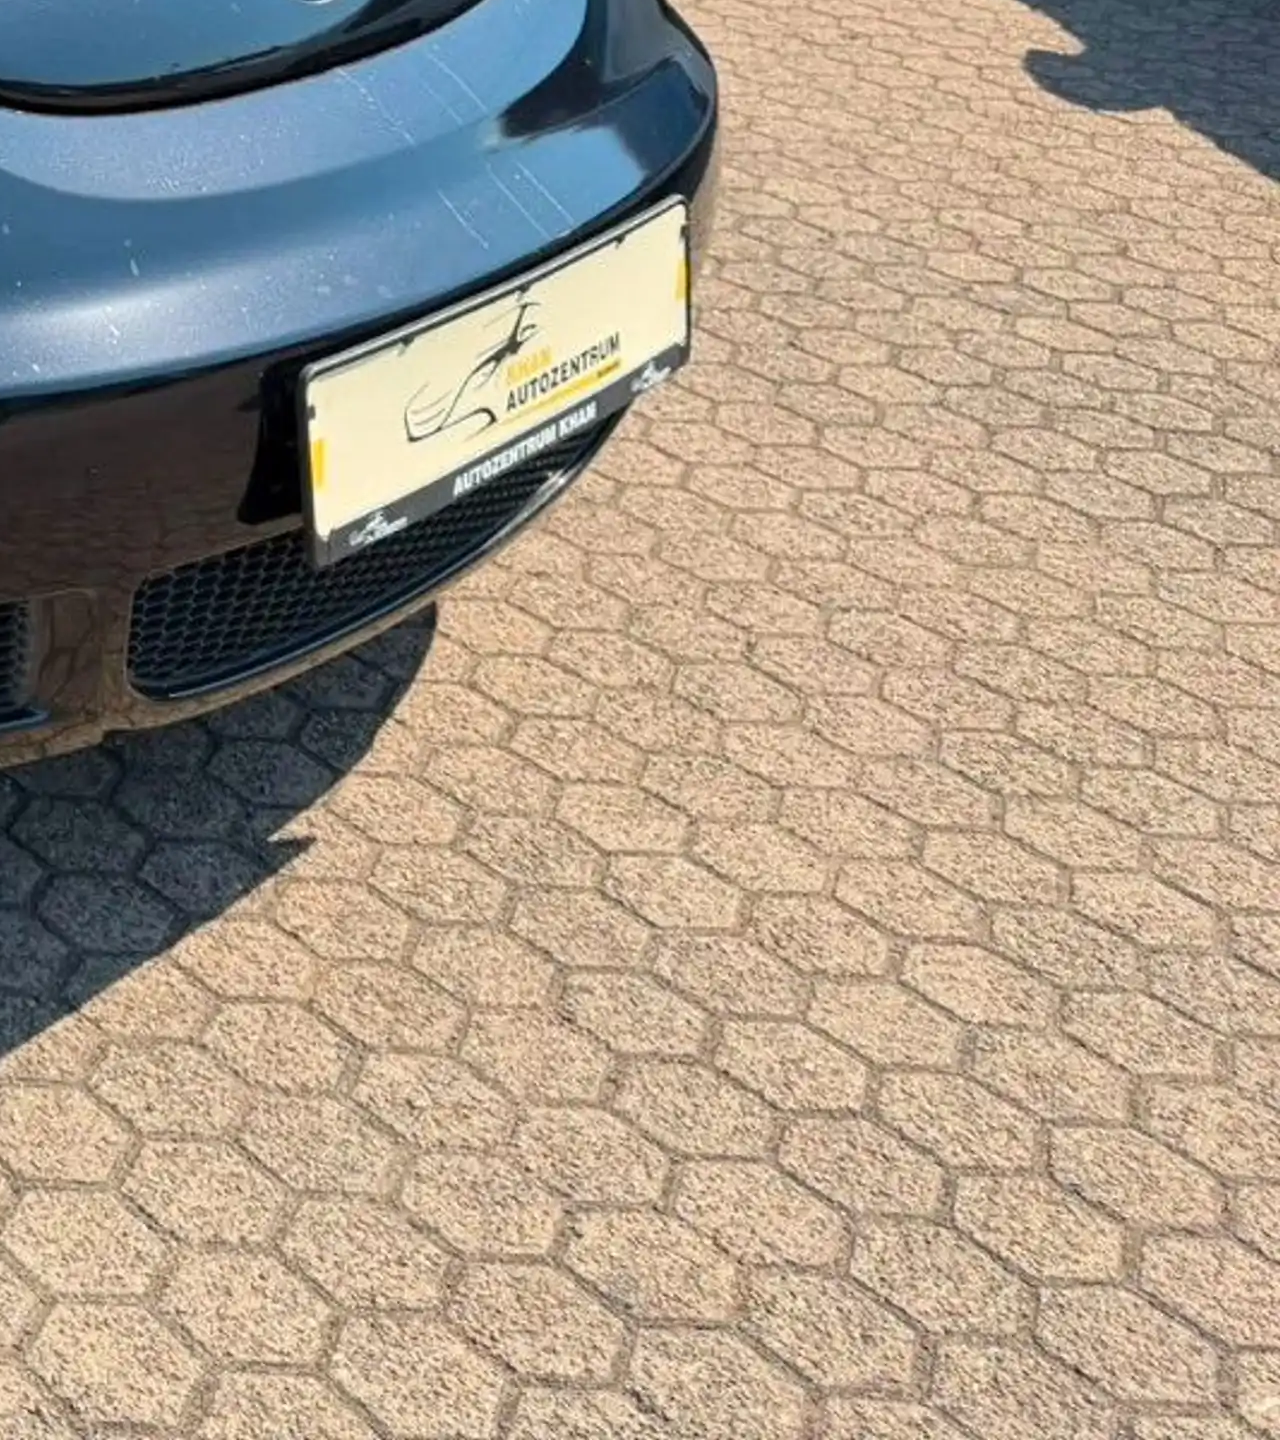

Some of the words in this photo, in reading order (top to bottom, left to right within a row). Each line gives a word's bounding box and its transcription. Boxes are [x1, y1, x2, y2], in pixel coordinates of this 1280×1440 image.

[506, 331, 621, 411] AUTOZENTRUM
[452, 424, 557, 496] AUTOZENTRUM
[558, 401, 598, 439] KHAN
